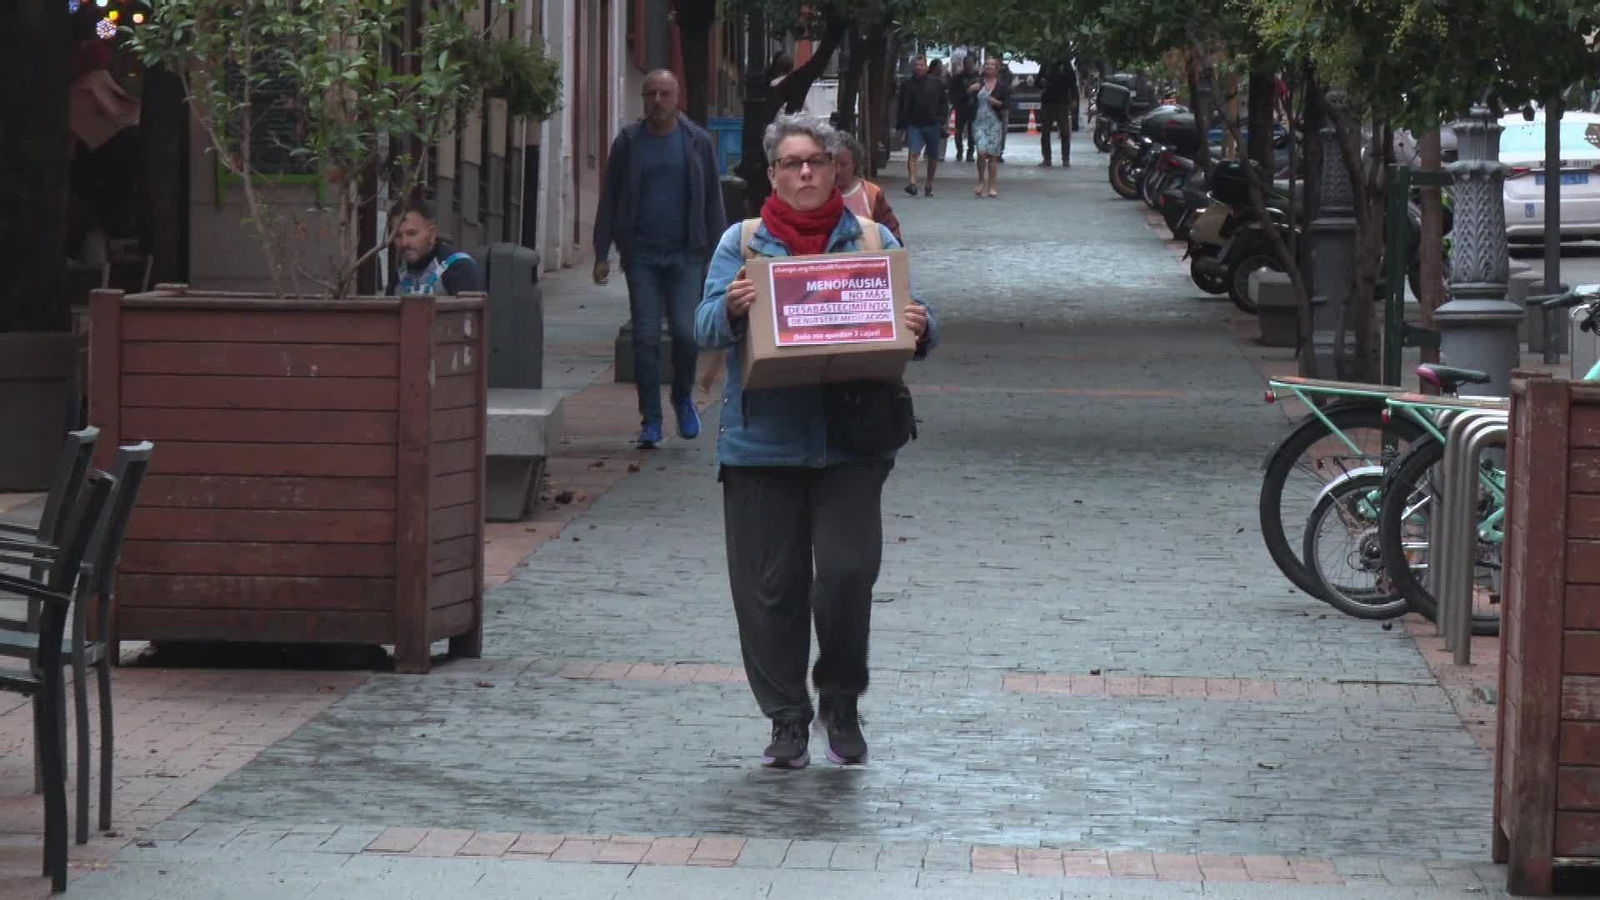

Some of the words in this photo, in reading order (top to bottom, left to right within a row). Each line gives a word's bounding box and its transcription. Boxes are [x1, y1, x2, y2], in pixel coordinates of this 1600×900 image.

[806, 277, 887, 292] MENOPAUSIA:
[848, 291, 863, 301] NO
[787, 301, 889, 314] DESABASTECIMIENTO
[803, 316, 840, 325] NUESTRA
